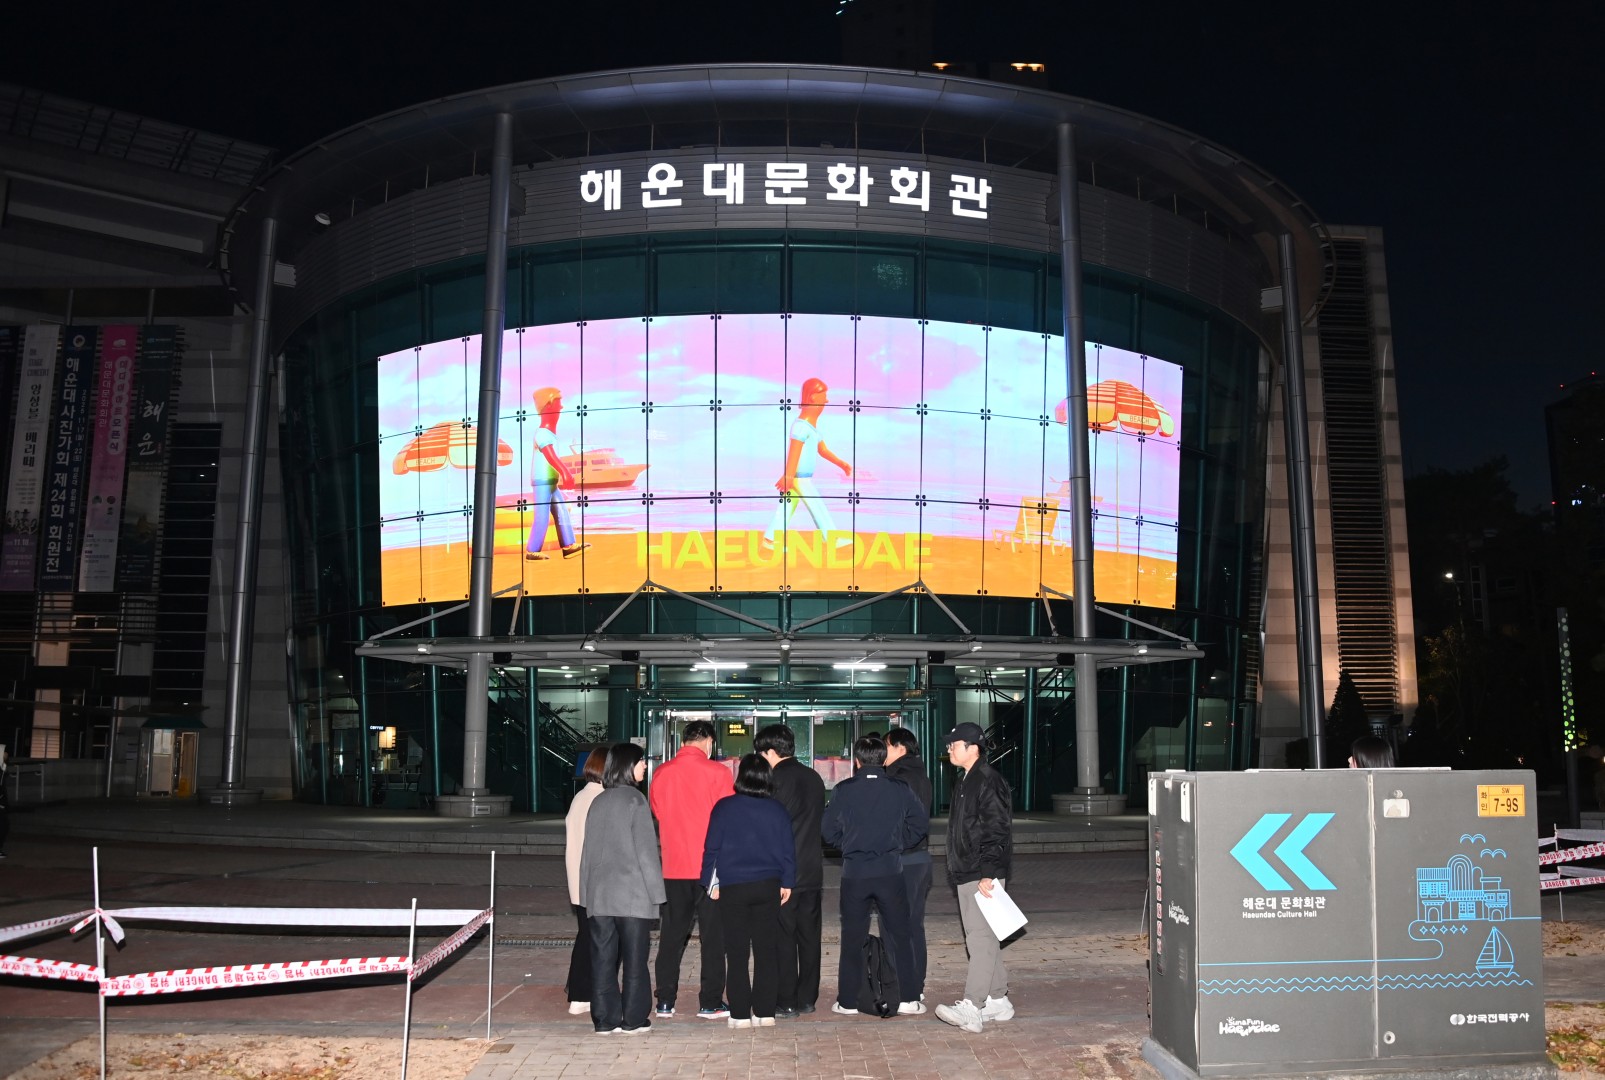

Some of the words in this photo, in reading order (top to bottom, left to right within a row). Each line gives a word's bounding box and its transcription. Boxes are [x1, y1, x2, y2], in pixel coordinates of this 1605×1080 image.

[580, 162, 993, 219] 해운대문화회관
[55, 357, 80, 466] 해운대사진가회
[1129, 414, 1150, 424] BEACH
[50, 472, 68, 519] 제24회
[46, 525, 62, 573] 회원전
[636, 529, 934, 570] HAEUNDAE
[1493, 797, 1519, 812] 7-9S
[1242, 897, 1277, 910] 해운대
[1281, 896, 1326, 910] 문화회관
[1242, 911, 1276, 919] Haeundae
[1277, 910, 1303, 918] Culture
[150, 976, 170, 988] 위험
[175, 975, 218, 986] DANGER!
[223, 971, 267, 984] 안전제일
[1466, 1012, 1530, 1024] 한국전력공사
